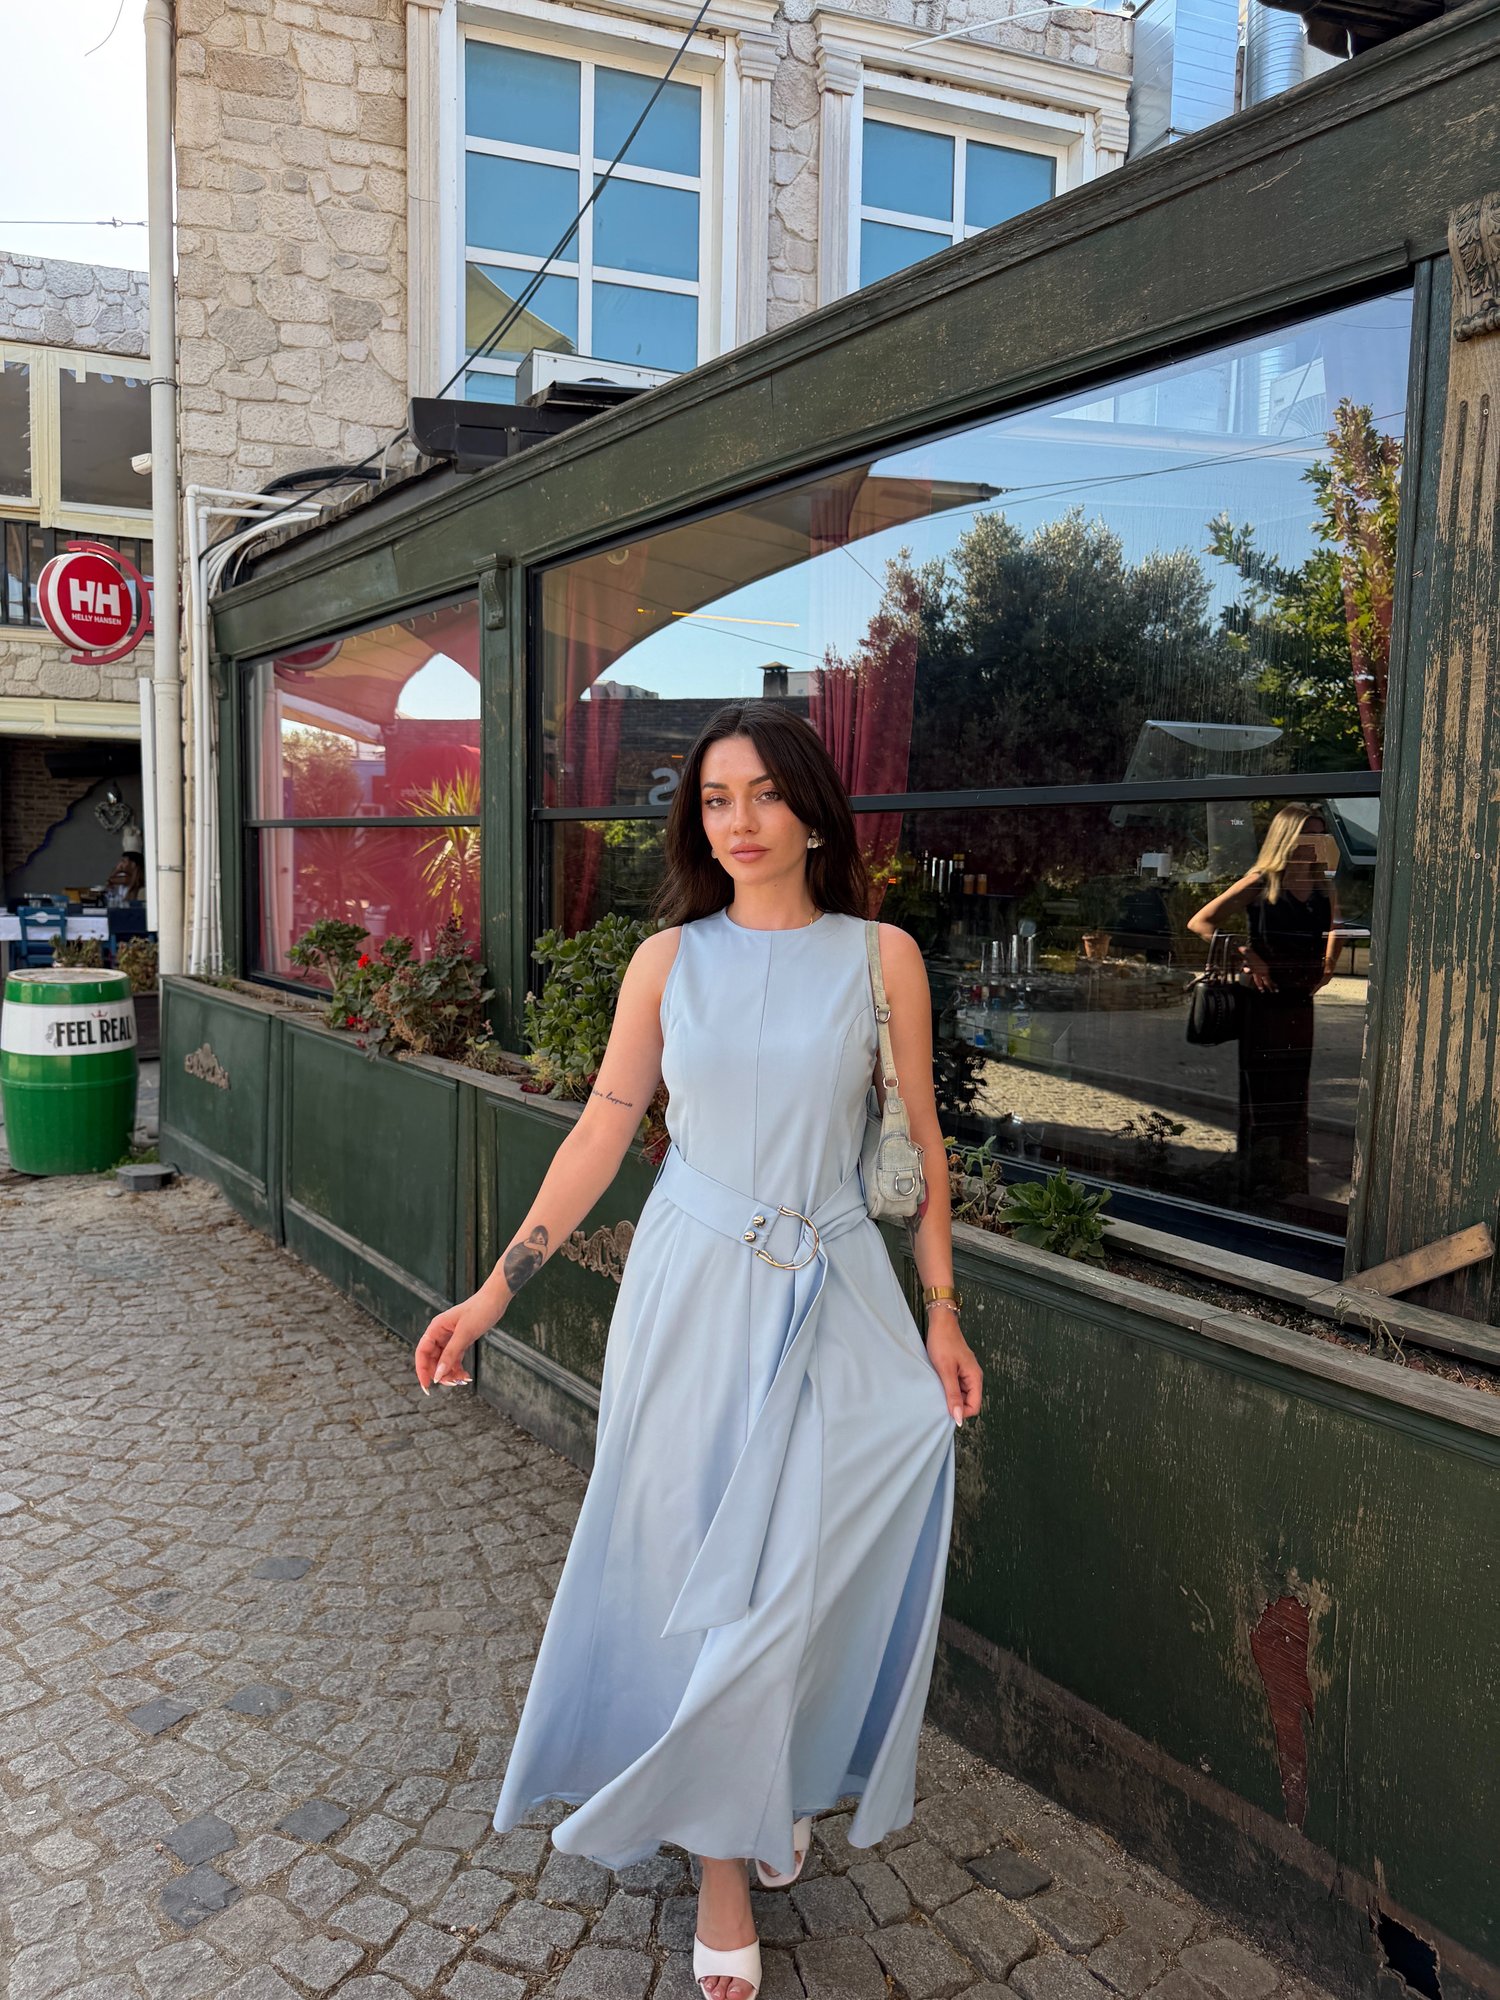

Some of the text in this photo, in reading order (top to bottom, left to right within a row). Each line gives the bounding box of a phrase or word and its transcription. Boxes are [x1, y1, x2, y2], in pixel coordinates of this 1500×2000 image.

[69, 578, 121, 617] HH
[72, 613, 121, 625] HELLY HANSEN
[56, 1016, 132, 1047] FEEL REAL
